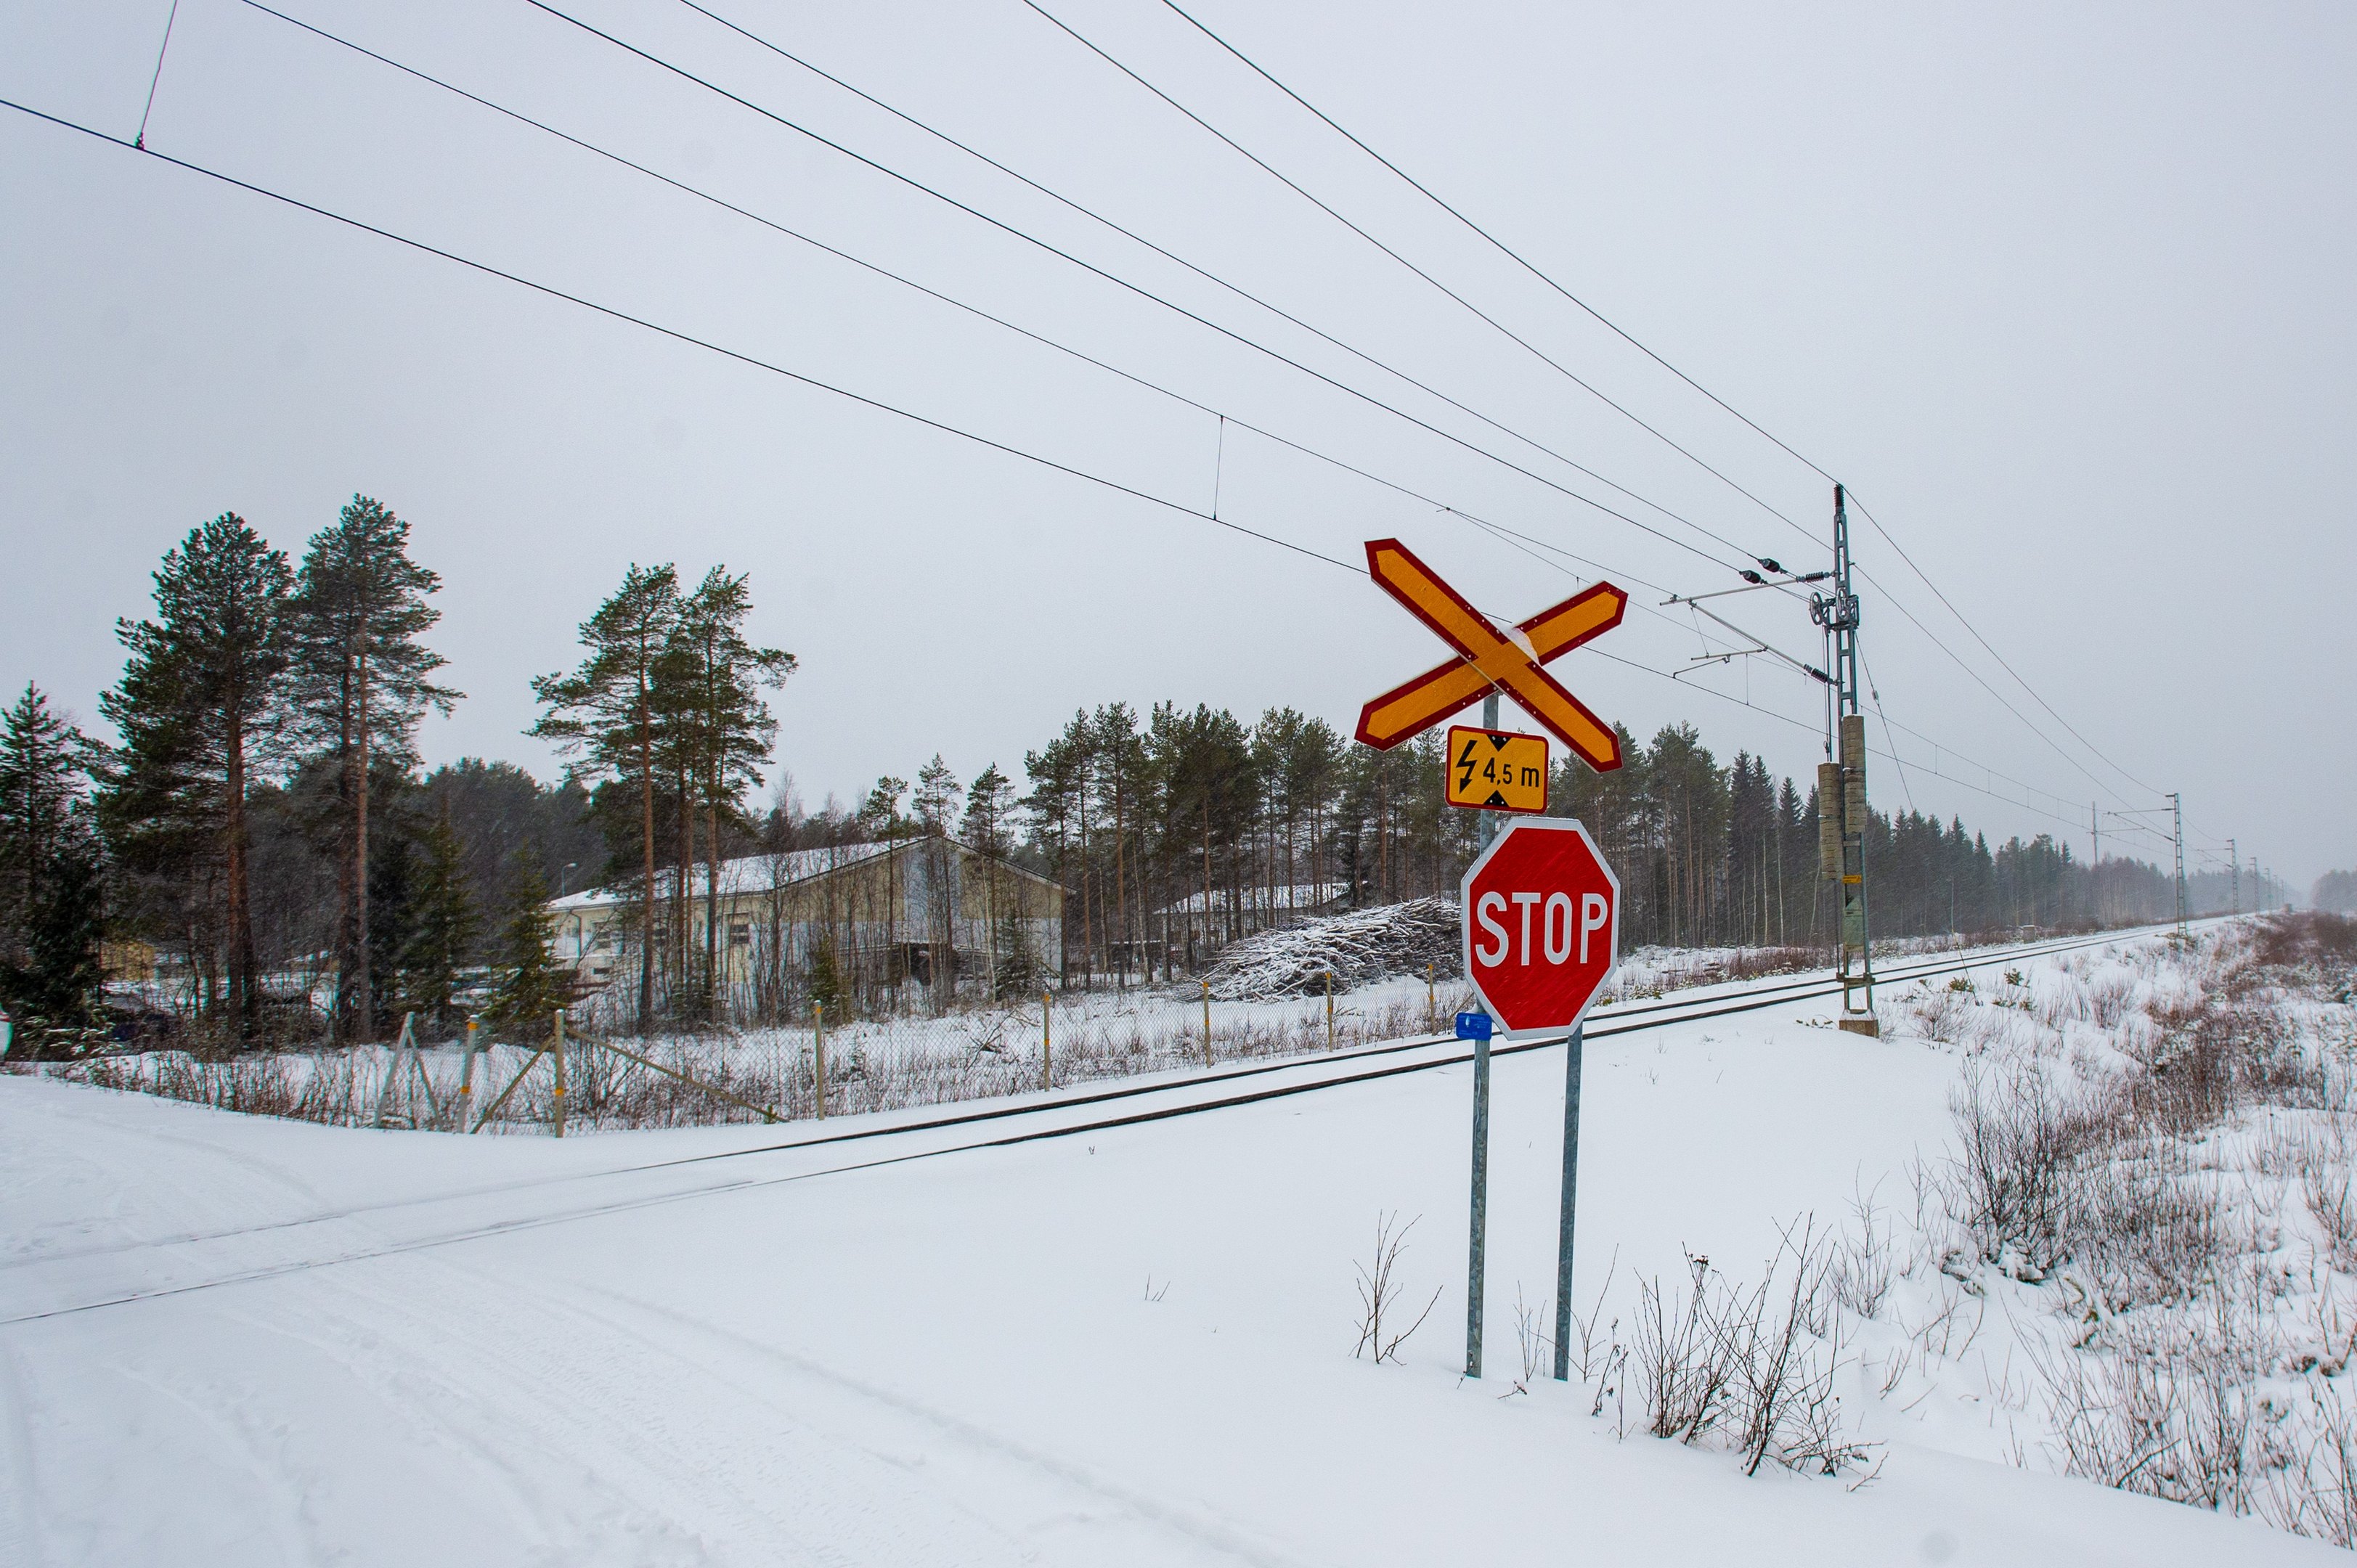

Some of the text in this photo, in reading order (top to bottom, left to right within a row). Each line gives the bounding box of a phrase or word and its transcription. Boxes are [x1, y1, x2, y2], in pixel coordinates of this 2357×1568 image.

[1483, 757, 1539, 788] 4,5 m
[1475, 891, 1608, 968] STOP
